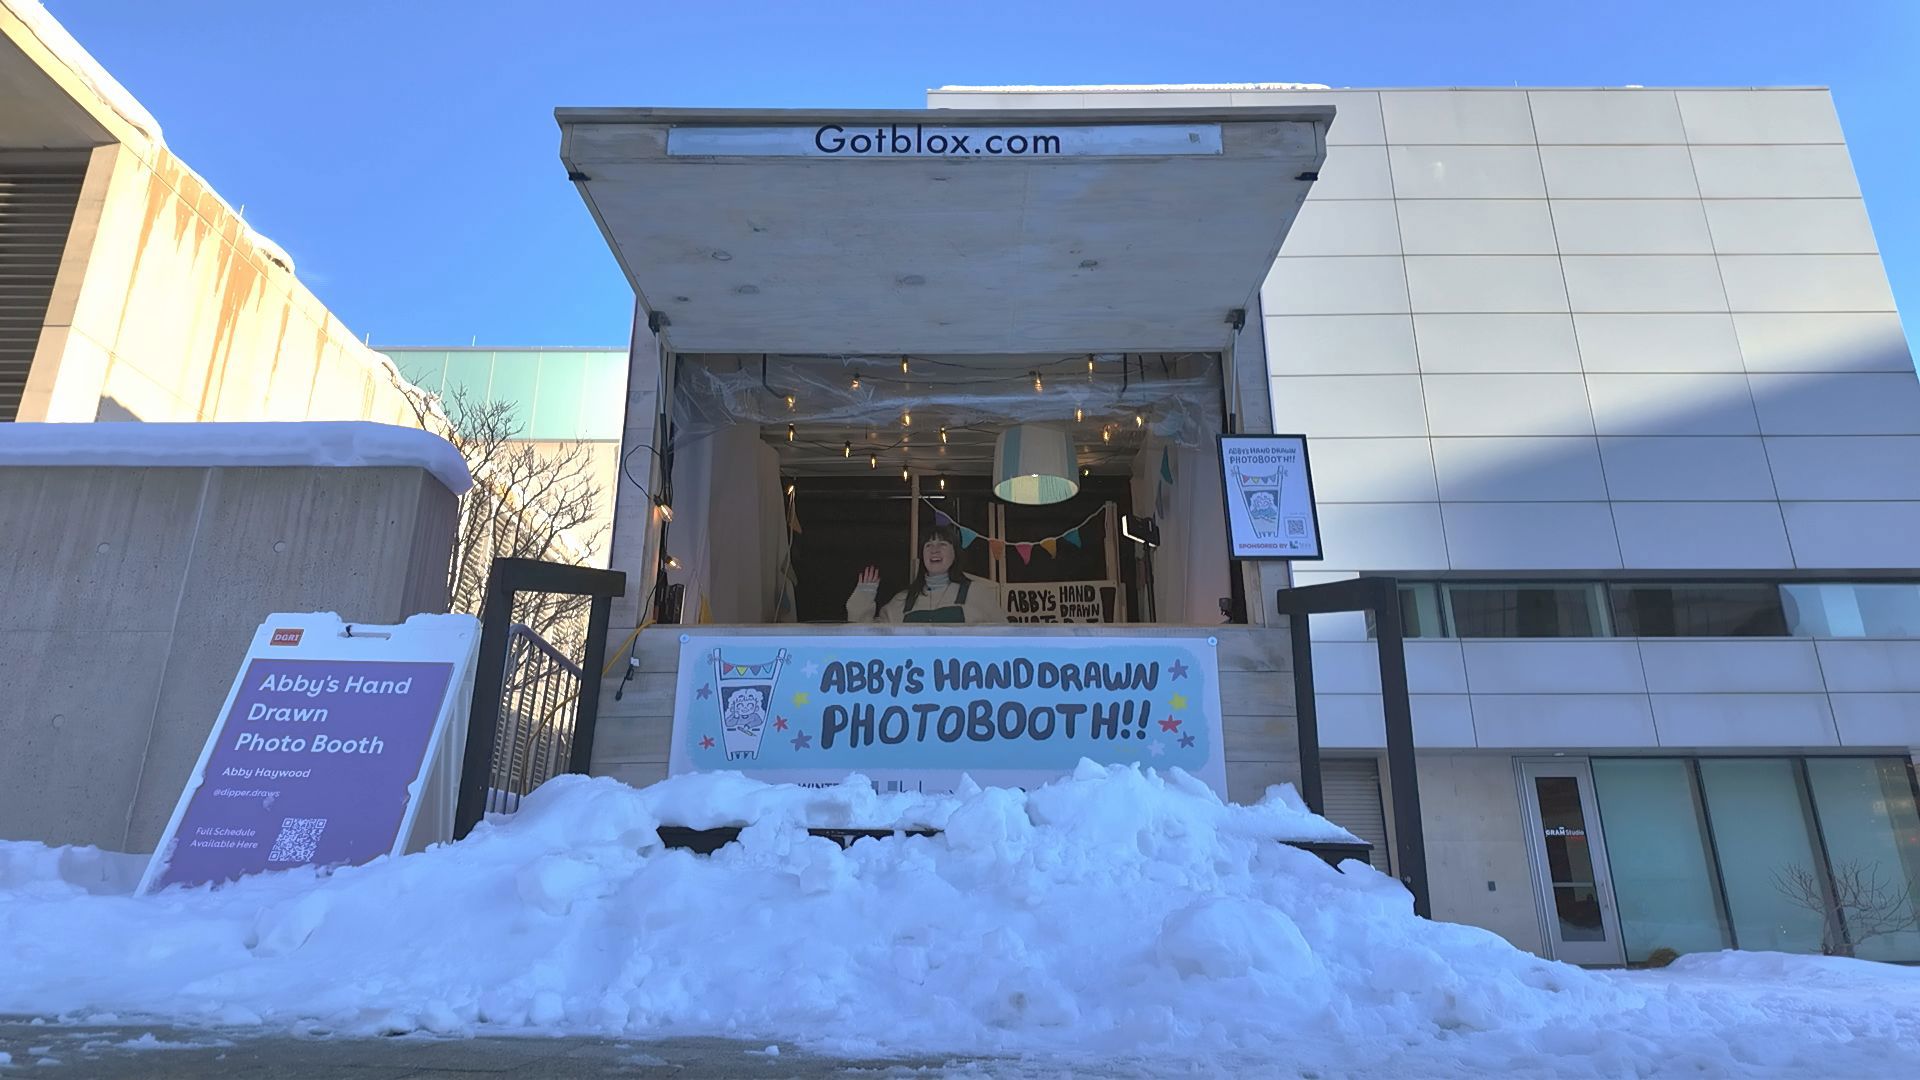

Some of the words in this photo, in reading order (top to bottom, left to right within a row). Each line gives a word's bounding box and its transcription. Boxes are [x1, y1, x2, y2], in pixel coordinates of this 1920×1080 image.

[815, 125, 1061, 155] Gotblox.com
[1059, 585, 1095, 603] HAND
[1060, 603, 1100, 617] DRAWN
[274, 633, 299, 641] DGRI
[933, 658, 1034, 692] HAND
[1037, 661, 1159, 692] DRAWN
[258, 674, 339, 697] Abby's
[344, 676, 412, 694] Hand
[247, 703, 328, 722] Drawn
[821, 699, 1151, 749] PHOTOBOOTH!!
[234, 733, 306, 753] Photo
[311, 734, 384, 754] Booth
[222, 767, 253, 779] Abby
[255, 768, 311, 779] Haywood
[213, 788, 280, 798] @dipper.draws
[196, 827, 212, 836] Full
[213, 828, 256, 836] Schedule
[190, 840, 235, 848] Available
[236, 841, 258, 849] Here
